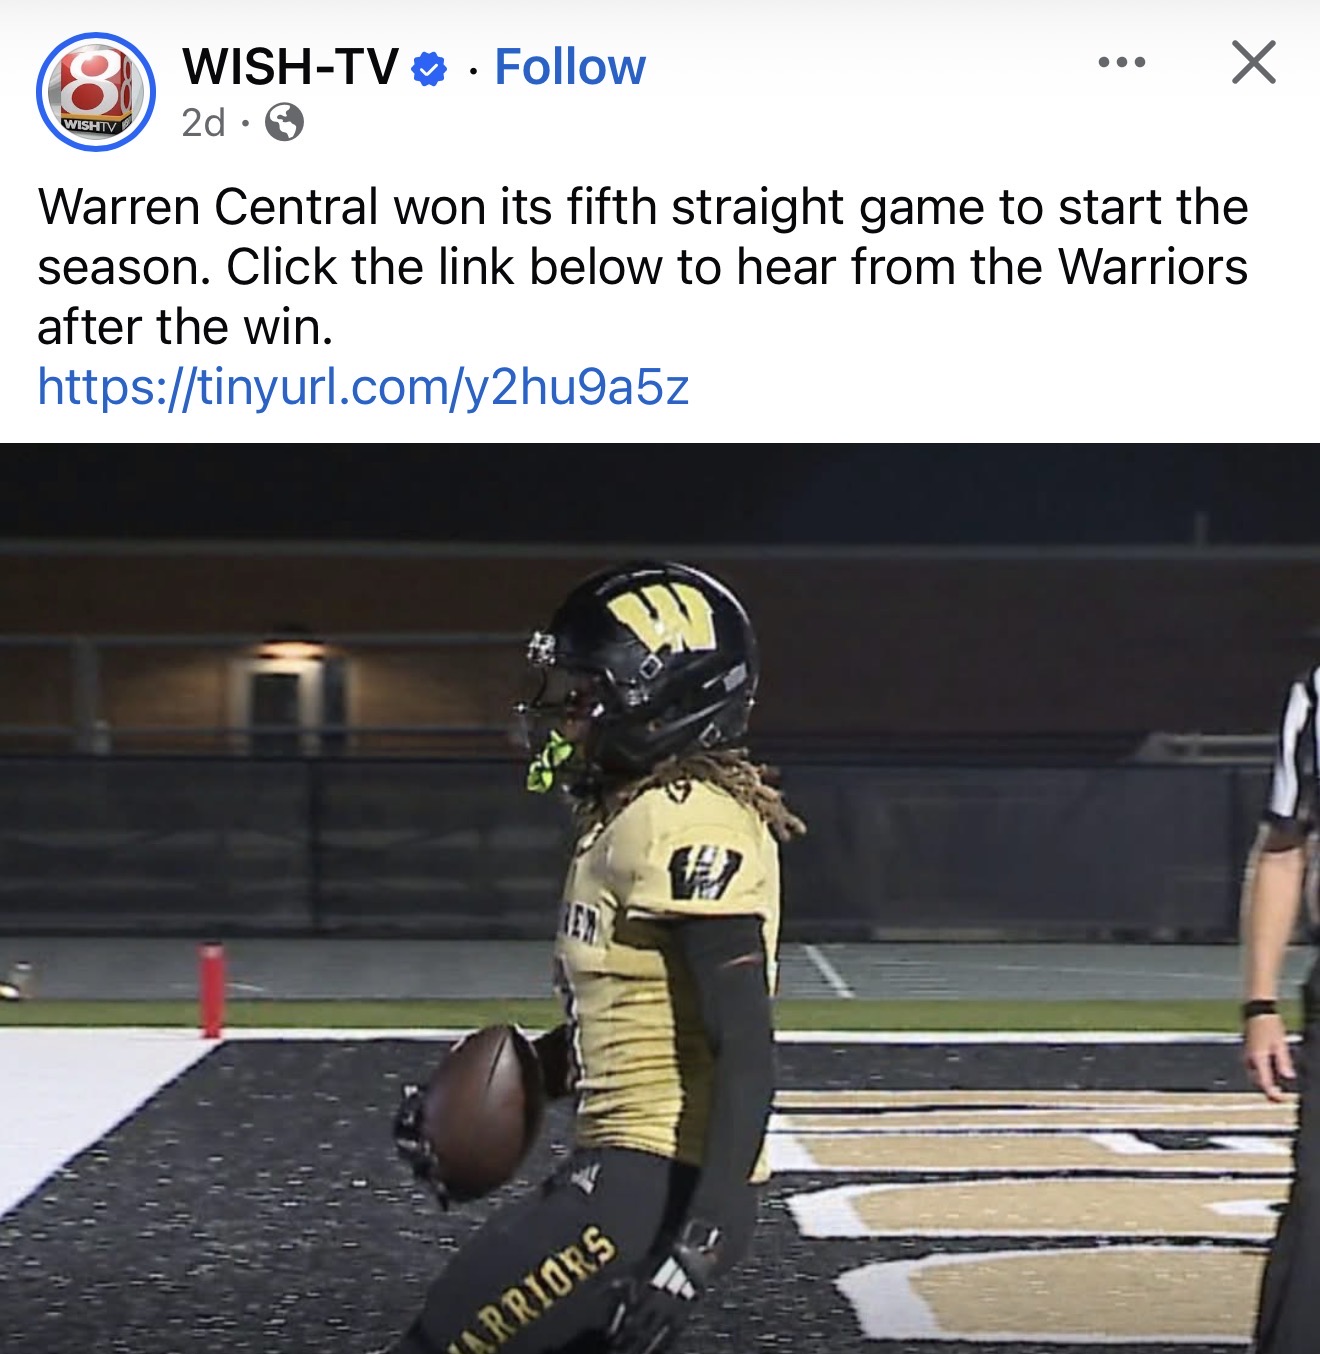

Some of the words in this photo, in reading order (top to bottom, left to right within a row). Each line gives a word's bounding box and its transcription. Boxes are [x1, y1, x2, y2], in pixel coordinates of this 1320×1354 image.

[61, 49, 121, 115] 8
[182, 47, 399, 85] WISH-TV
[497, 46, 646, 85] Follow
[63, 119, 117, 132] WISHTV
[183, 107, 224, 136] 2d
[38, 188, 198, 225] Warren
[216, 186, 376, 225] Central
[394, 196, 484, 225] won
[502, 186, 551, 225] its
[567, 186, 655, 225] fifth
[673, 186, 843, 236] straight
[860, 196, 984, 236] game
[999, 190, 1043, 225] to
[1060, 190, 1161, 225] start
[1176, 186, 1248, 225] the
[39, 256, 209, 285] season.
[228, 246, 338, 285] Click
[351, 246, 423, 285] the
[441, 246, 515, 285] link
[532, 246, 663, 285] below
[677, 250, 721, 285] to
[739, 246, 836, 285] hear
[851, 246, 954, 285] from
[970, 246, 1042, 285] the
[1058, 246, 1247, 285] Warriors
[38, 306, 142, 345] after
[156, 306, 228, 345] the
[244, 306, 331, 345] win.
[40, 366, 688, 414] https://tinyurl.com/y2hu9a5z
[606, 582, 716, 654] W
[667, 845, 743, 900] W
